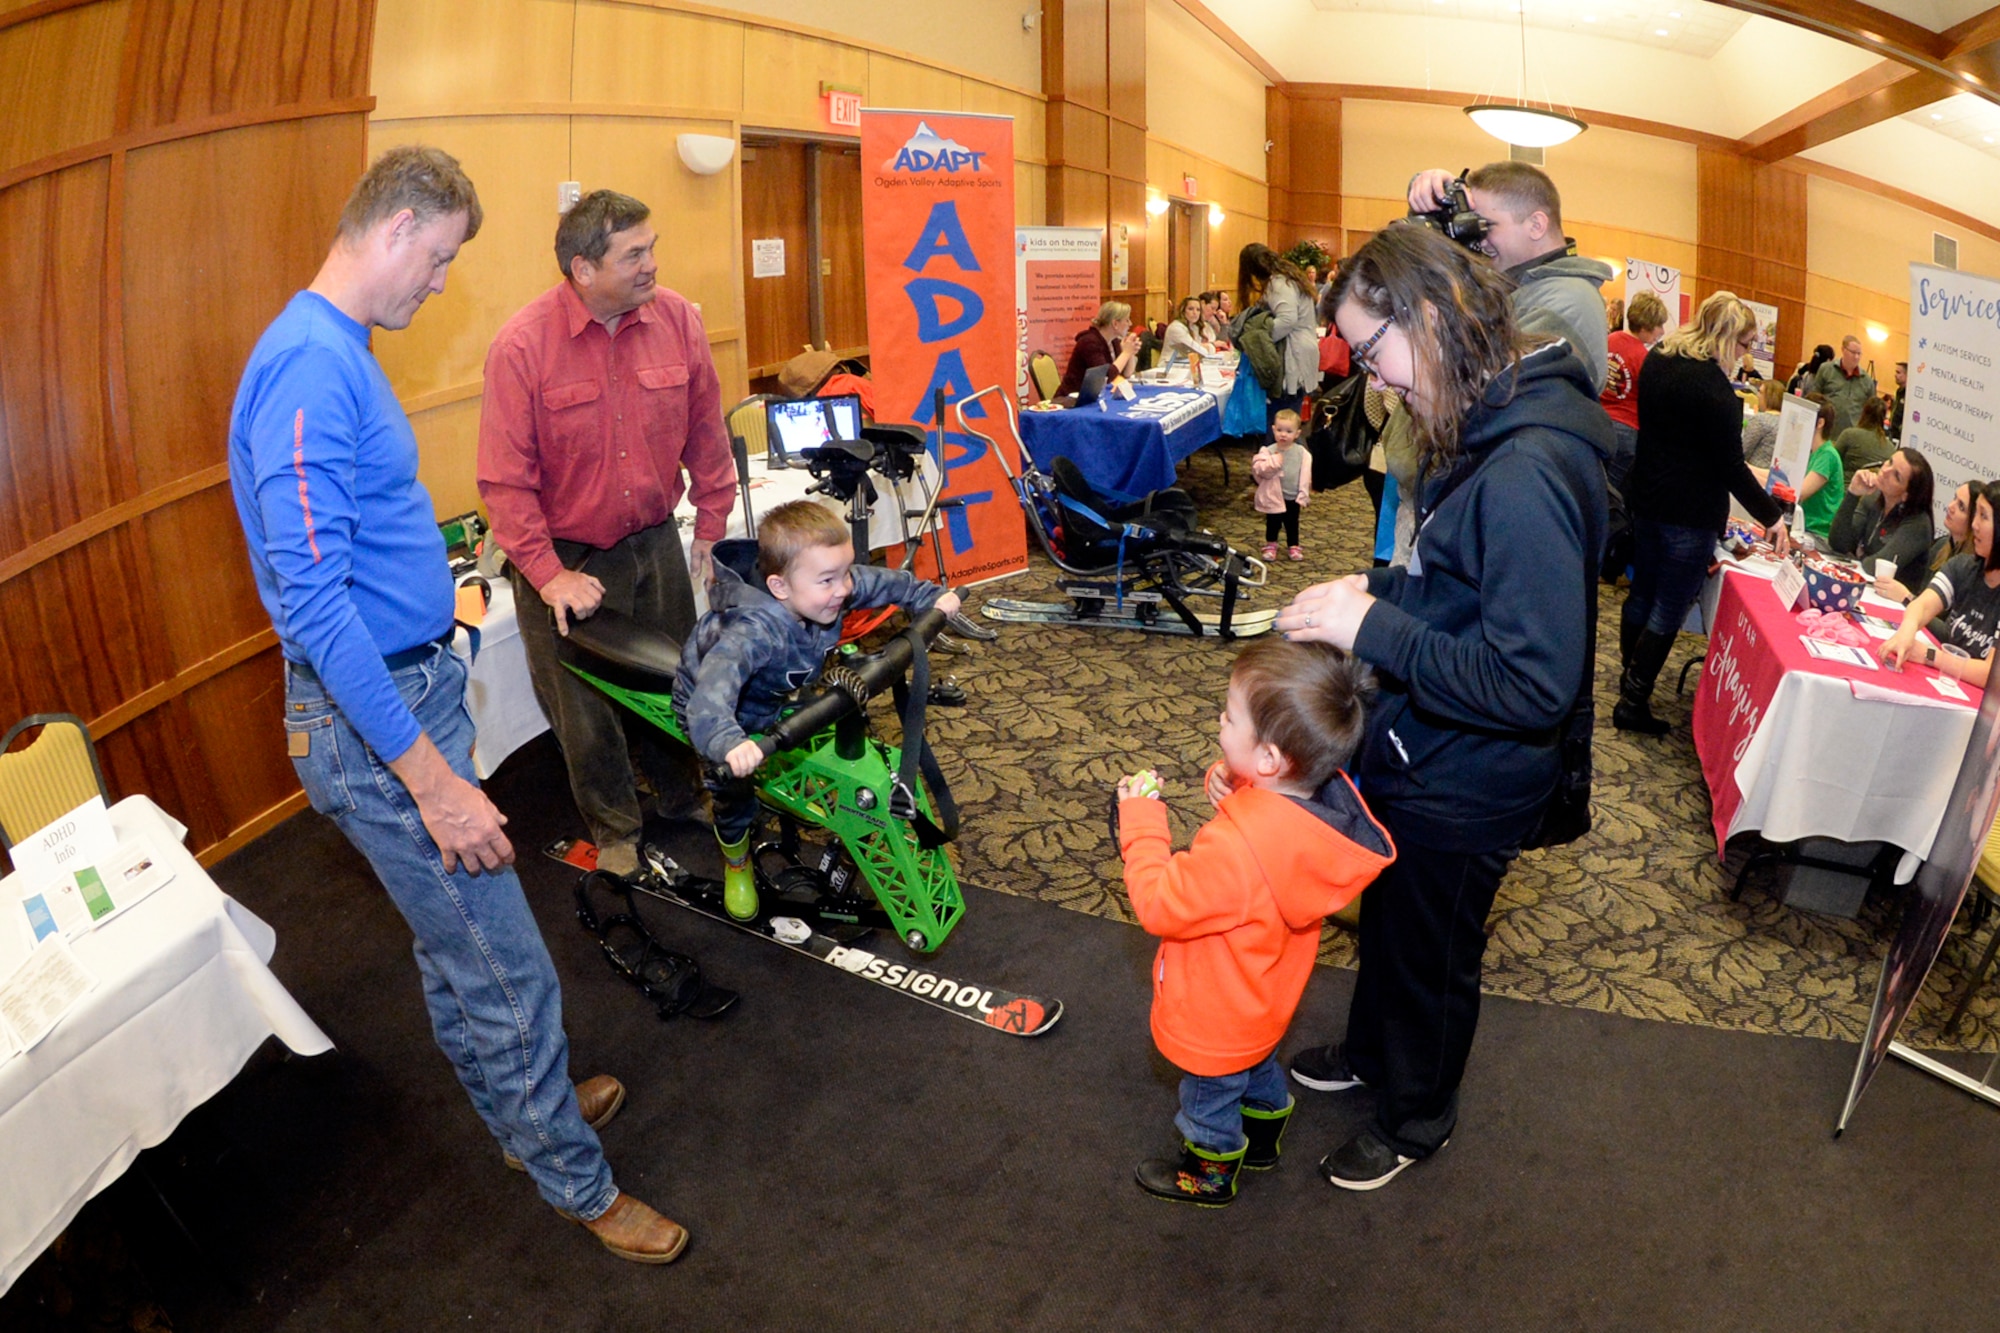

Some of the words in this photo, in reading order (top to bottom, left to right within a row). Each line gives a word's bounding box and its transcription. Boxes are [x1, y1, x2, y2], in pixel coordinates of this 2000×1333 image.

[837, 97, 858, 123] EXIT
[893, 147, 987, 173] ADAPT
[874, 177, 908, 188] Ogden
[909, 177, 935, 187] Valley
[938, 177, 975, 187] Adaptive
[977, 178, 1002, 187] Sports
[1030, 238, 1047, 246] kids
[1933, 342, 1959, 357] AUTISM
[1959, 349, 1992, 367] SERVICES
[1931, 366, 1957, 383] MENTAL
[1959, 376, 1984, 392] HEALTH
[1929, 391, 1963, 411] BEHAVIOR
[1964, 404, 1994, 422] THERAPY
[1926, 416, 1952, 434] SOCIAL
[1953, 427, 1975, 443] SKILLS
[1923, 441, 1981, 474] PSYCHOLOGICAL
[1738, 611, 1757, 648] UTAH
[1710, 635, 1759, 762] Amazing
[43, 821, 76, 852] ADHD
[54, 844, 77, 865] Info
